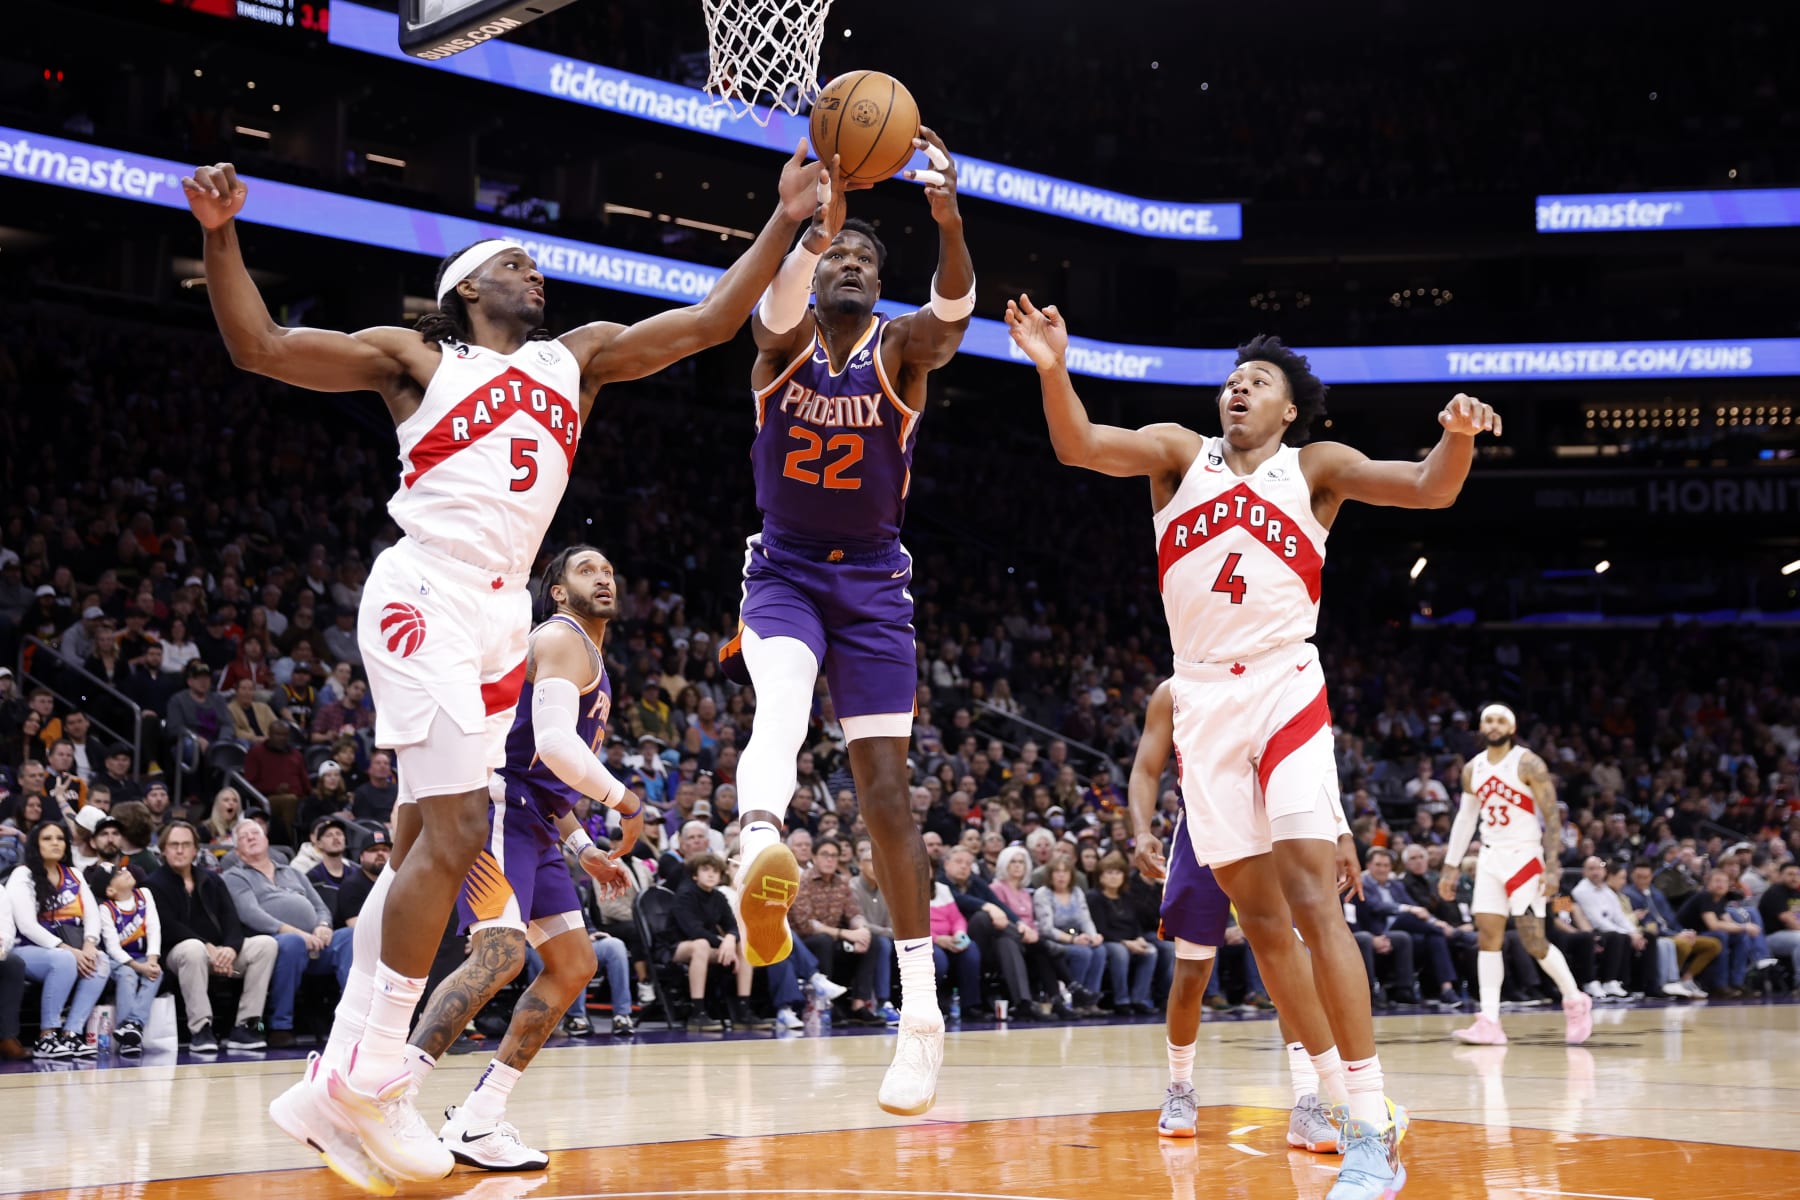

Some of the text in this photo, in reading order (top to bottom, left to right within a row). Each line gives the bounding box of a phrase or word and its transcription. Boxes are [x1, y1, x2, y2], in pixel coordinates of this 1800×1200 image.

[417, 17, 522, 60] SUNS.COM
[550, 62, 728, 131] ticketmaster
[996, 171, 1051, 207] ONLY
[1052, 185, 1140, 228] HAPPENS
[1141, 205, 1218, 235] ONCE.
[1446, 347, 1753, 375] TICKETMASTER.COM/SUNS
[451, 379, 575, 445] RAPTORS
[779, 379, 884, 428] PHOENIX
[509, 437, 539, 493] 5
[782, 425, 865, 490] 22
[1174, 495, 1298, 559] RAPTORS
[1210, 552, 1248, 605] 4
[1487, 805, 1511, 827] 33
